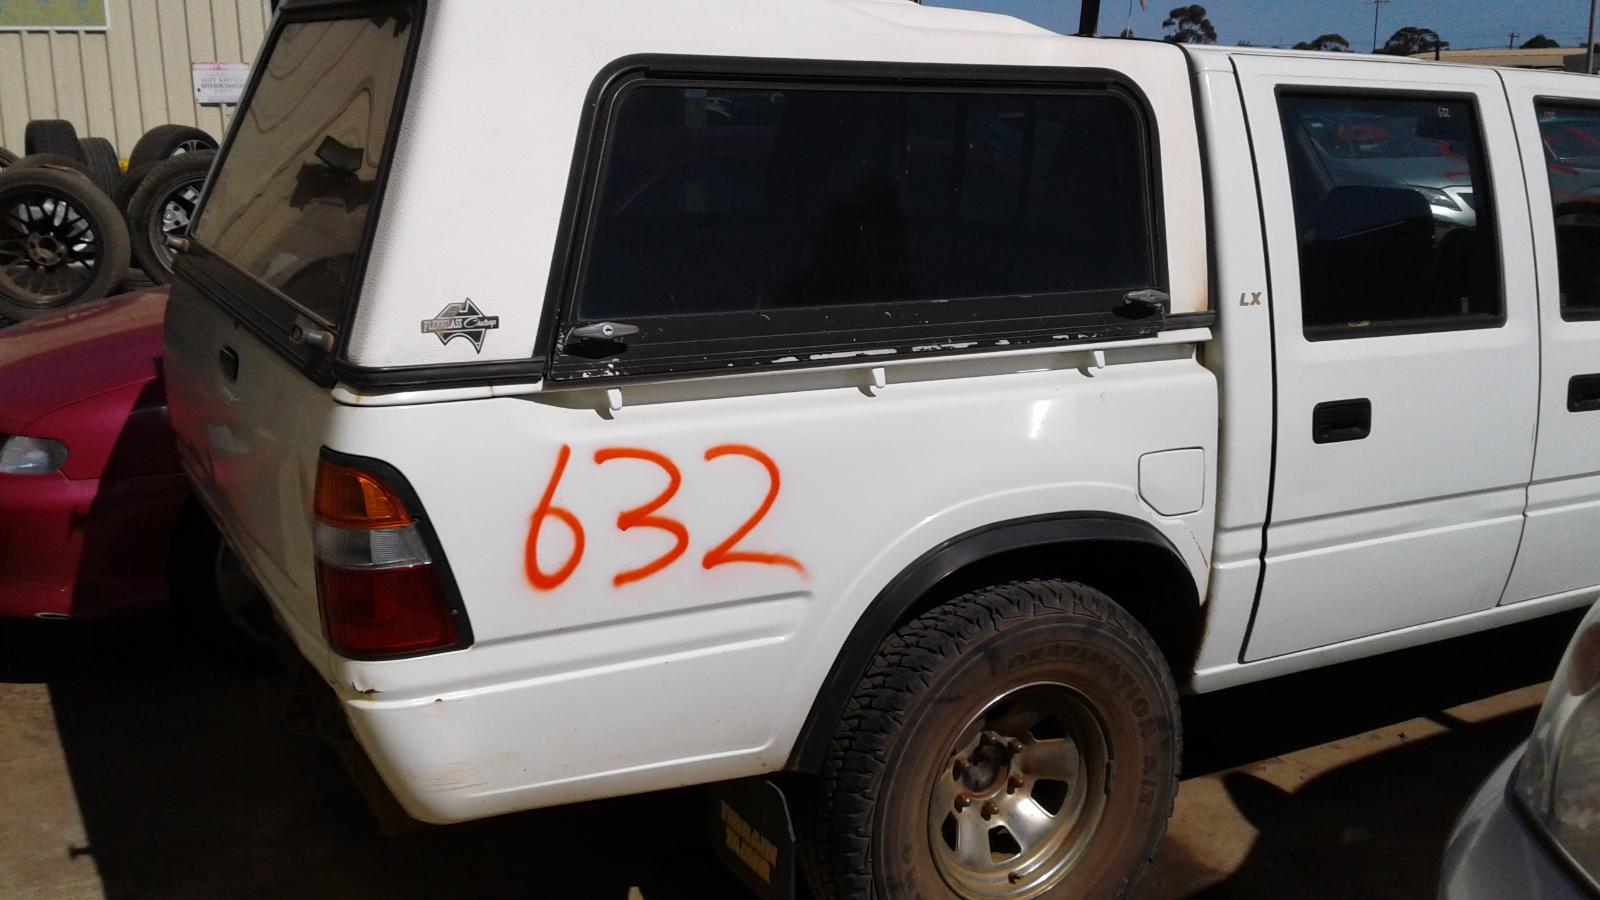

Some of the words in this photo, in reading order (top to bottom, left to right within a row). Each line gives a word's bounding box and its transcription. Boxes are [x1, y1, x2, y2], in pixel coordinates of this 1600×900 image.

[1239, 291, 1262, 307] LX
[524, 443, 810, 592] 632
[1008, 644, 1158, 738] DESTINATION
